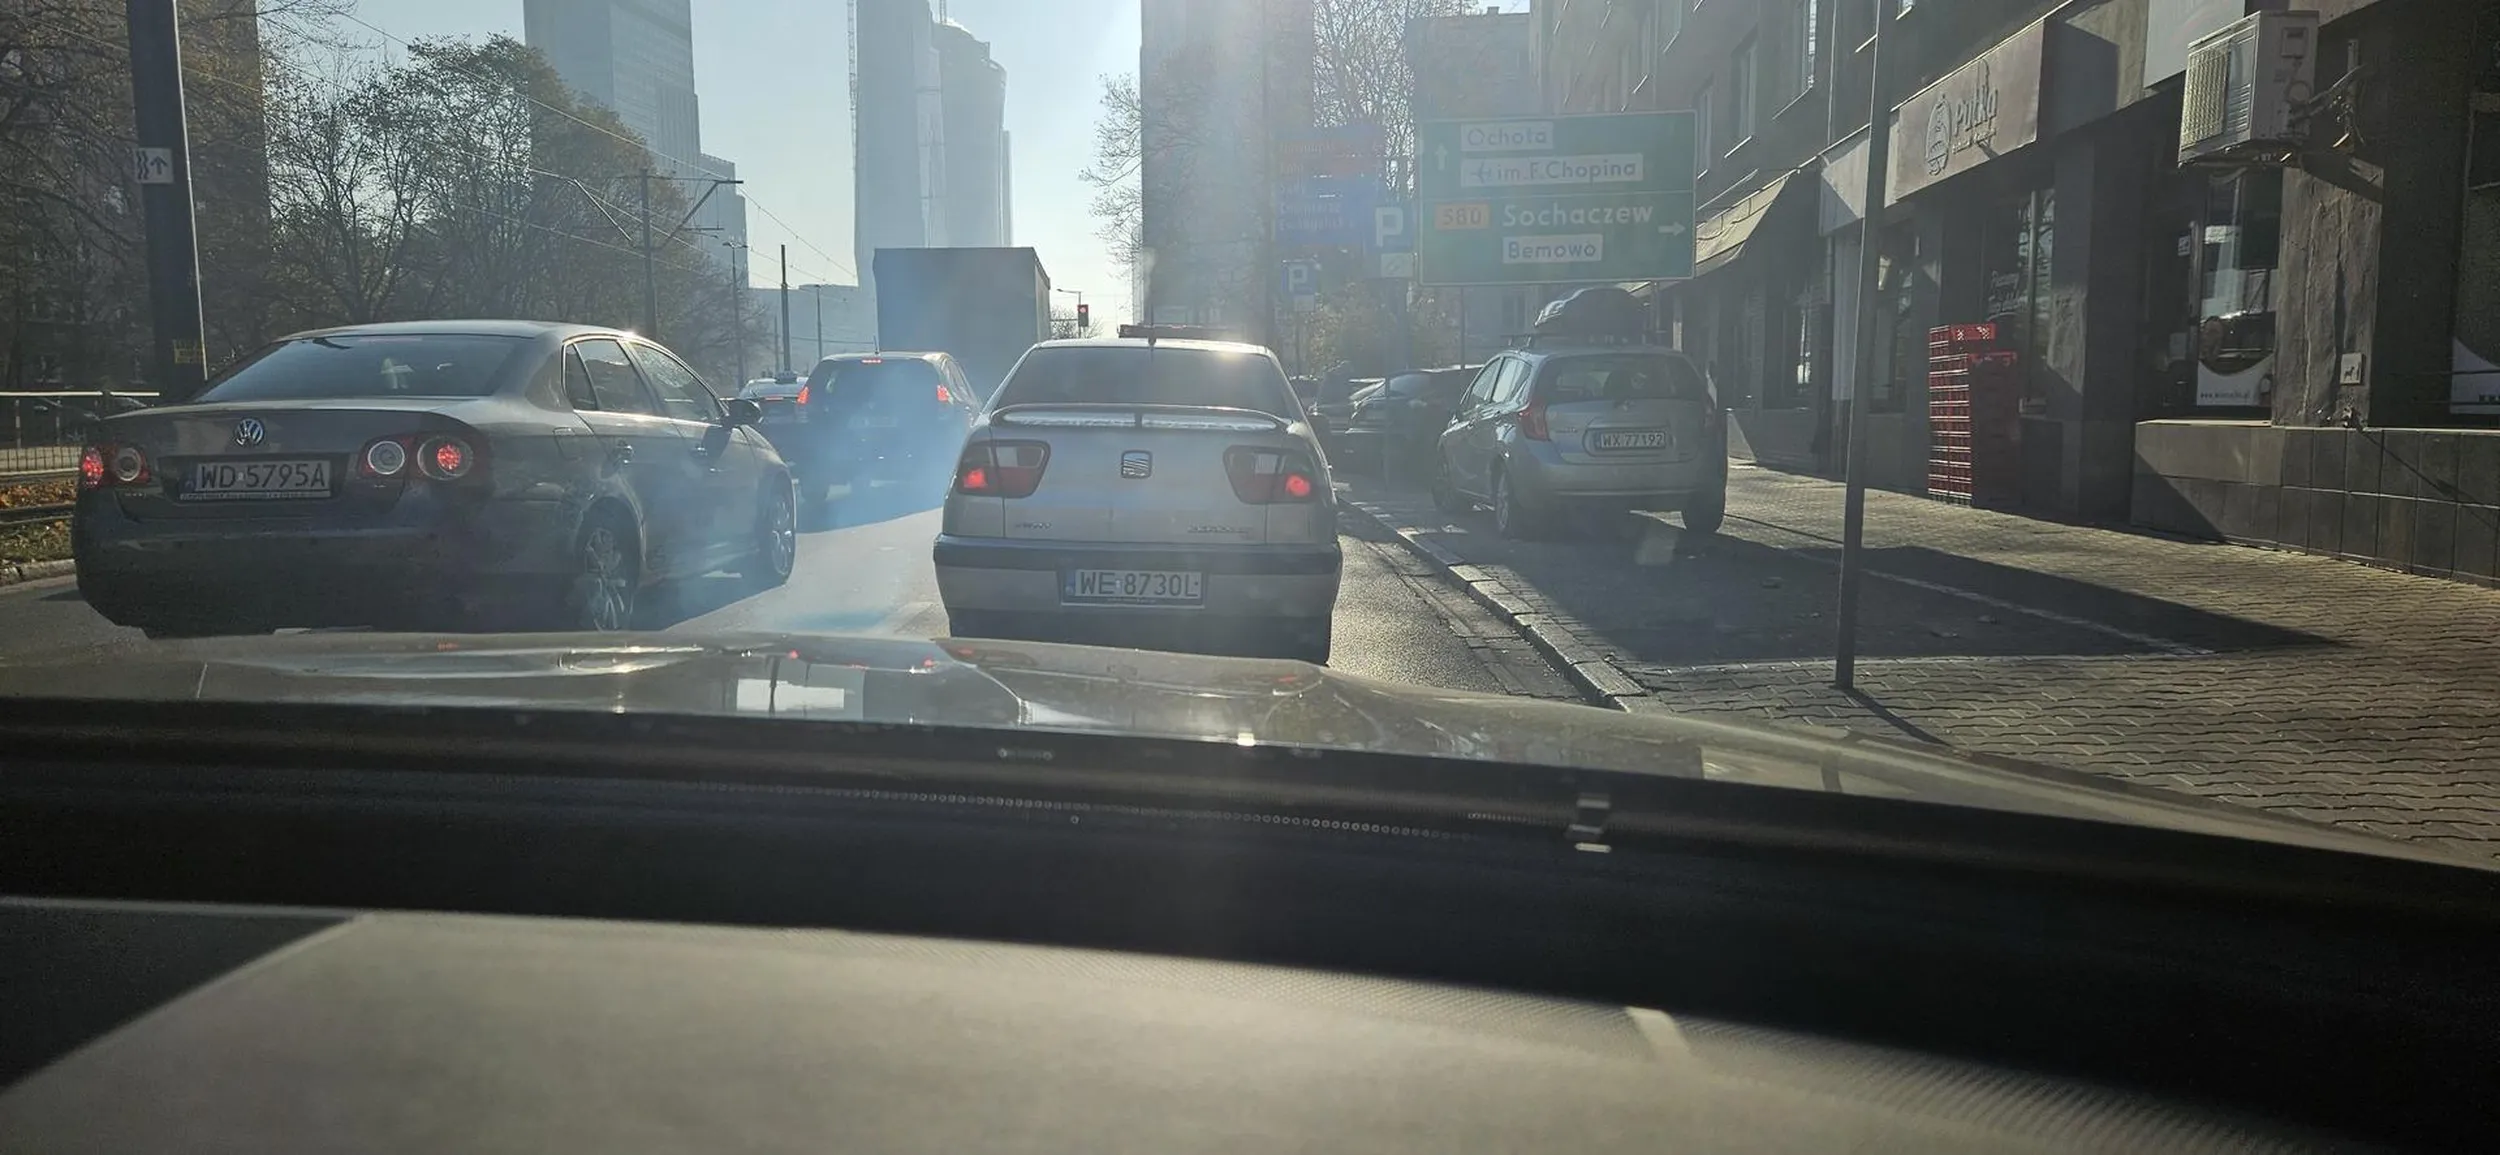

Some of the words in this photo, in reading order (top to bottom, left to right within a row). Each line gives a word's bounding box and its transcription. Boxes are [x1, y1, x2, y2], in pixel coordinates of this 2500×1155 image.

[1467, 128, 1548, 147] Ochota
[1375, 206, 1404, 247] P
[1501, 203, 1654, 227] Sochaczew
[1507, 240, 1597, 259] Bemowo
[1288, 264, 1308, 292] P
[201, 464, 236, 488] WD
[246, 462, 325, 488] 5795A
[1080, 571, 1115, 595] WE
[1124, 573, 1198, 597] 8730L
